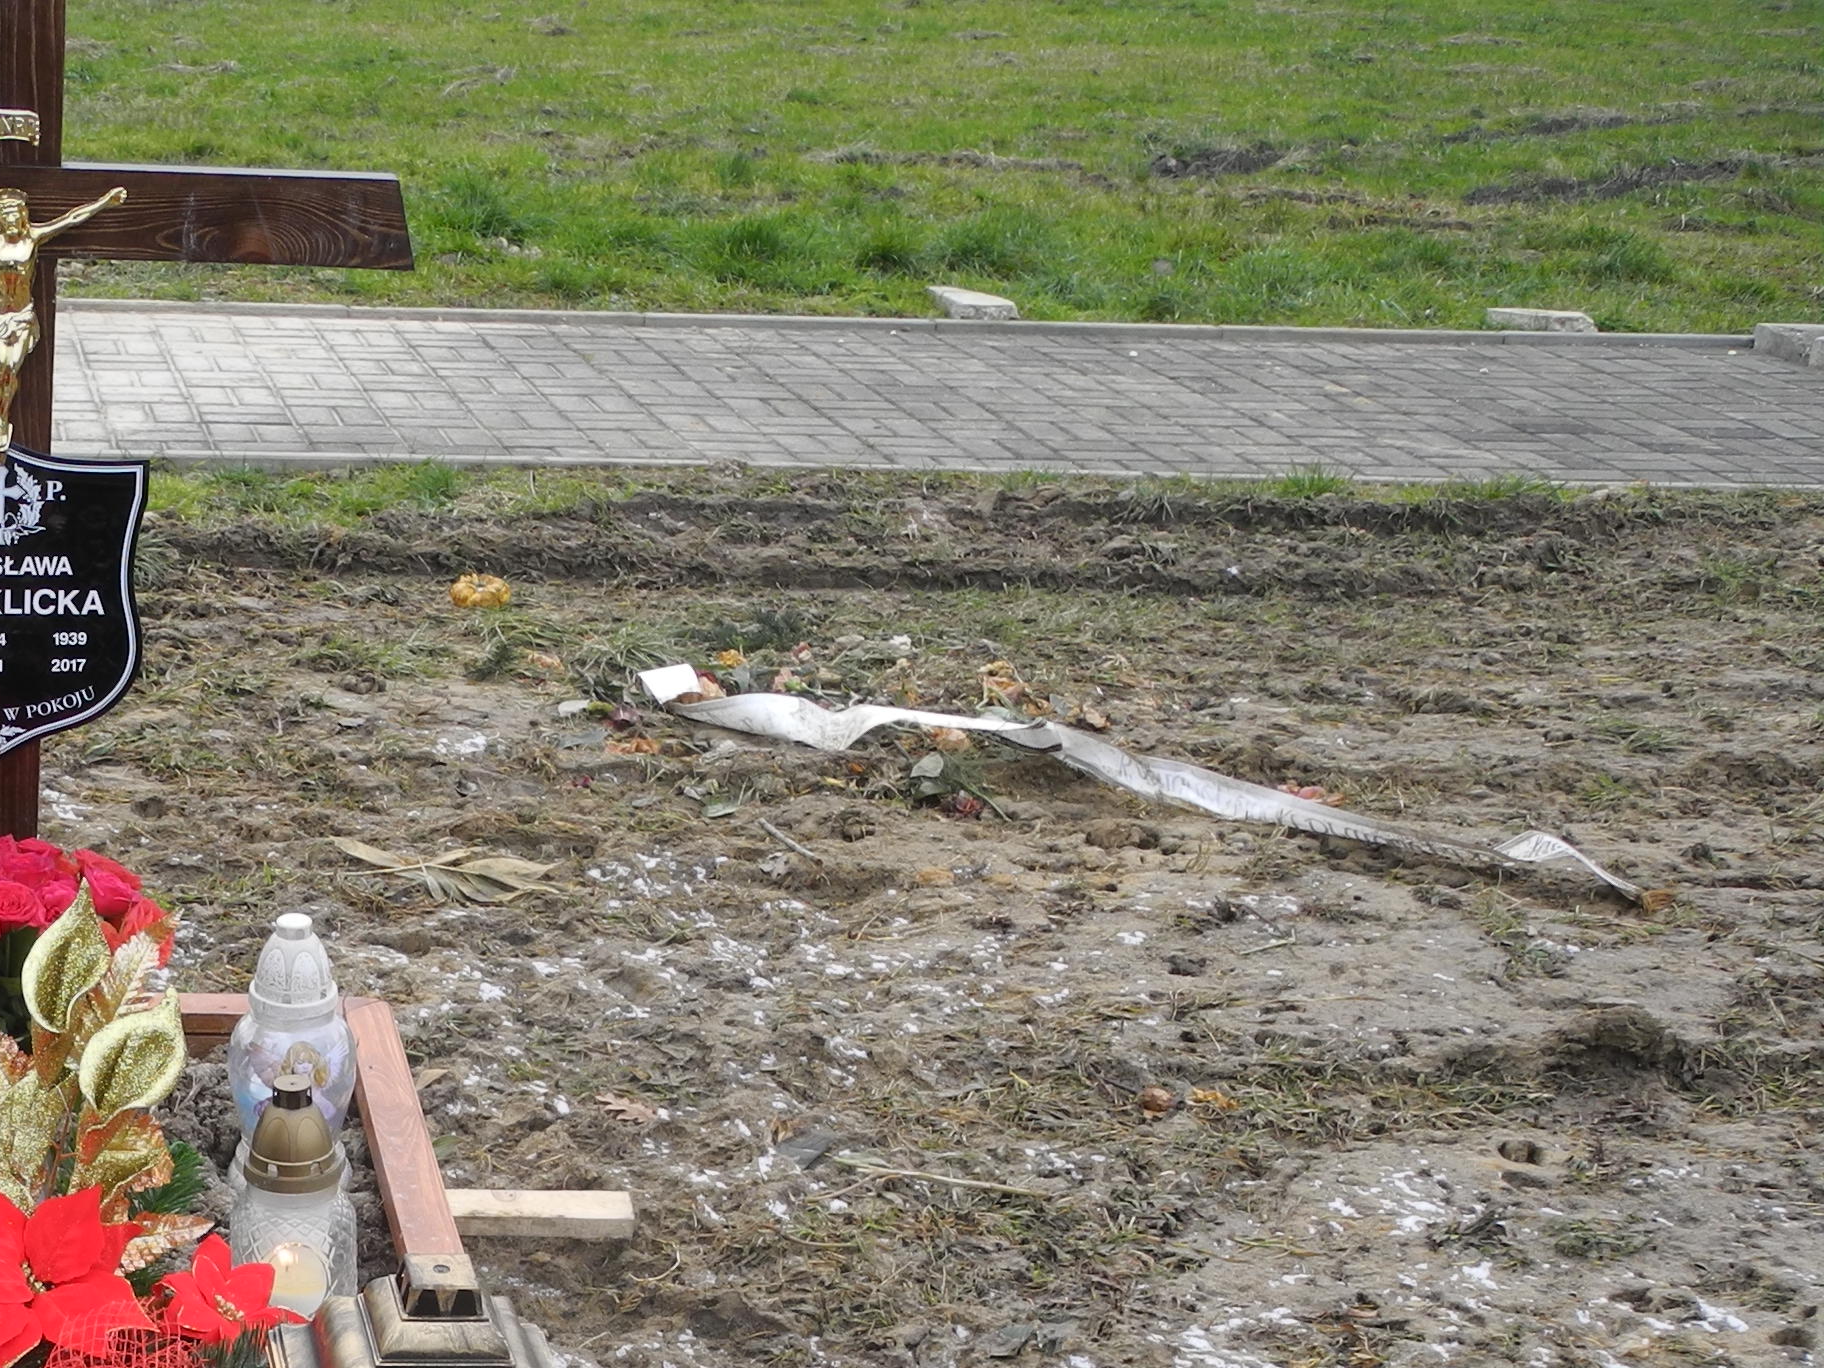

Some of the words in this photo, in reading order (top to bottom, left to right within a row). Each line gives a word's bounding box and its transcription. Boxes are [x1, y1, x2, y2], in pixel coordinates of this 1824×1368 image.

[45, 480, 67, 501] P.
[52, 631, 88, 646] 1939
[50, 658, 87, 673] 2017
[2, 706, 20, 721] W
[26, 685, 96, 720] POKOJU
